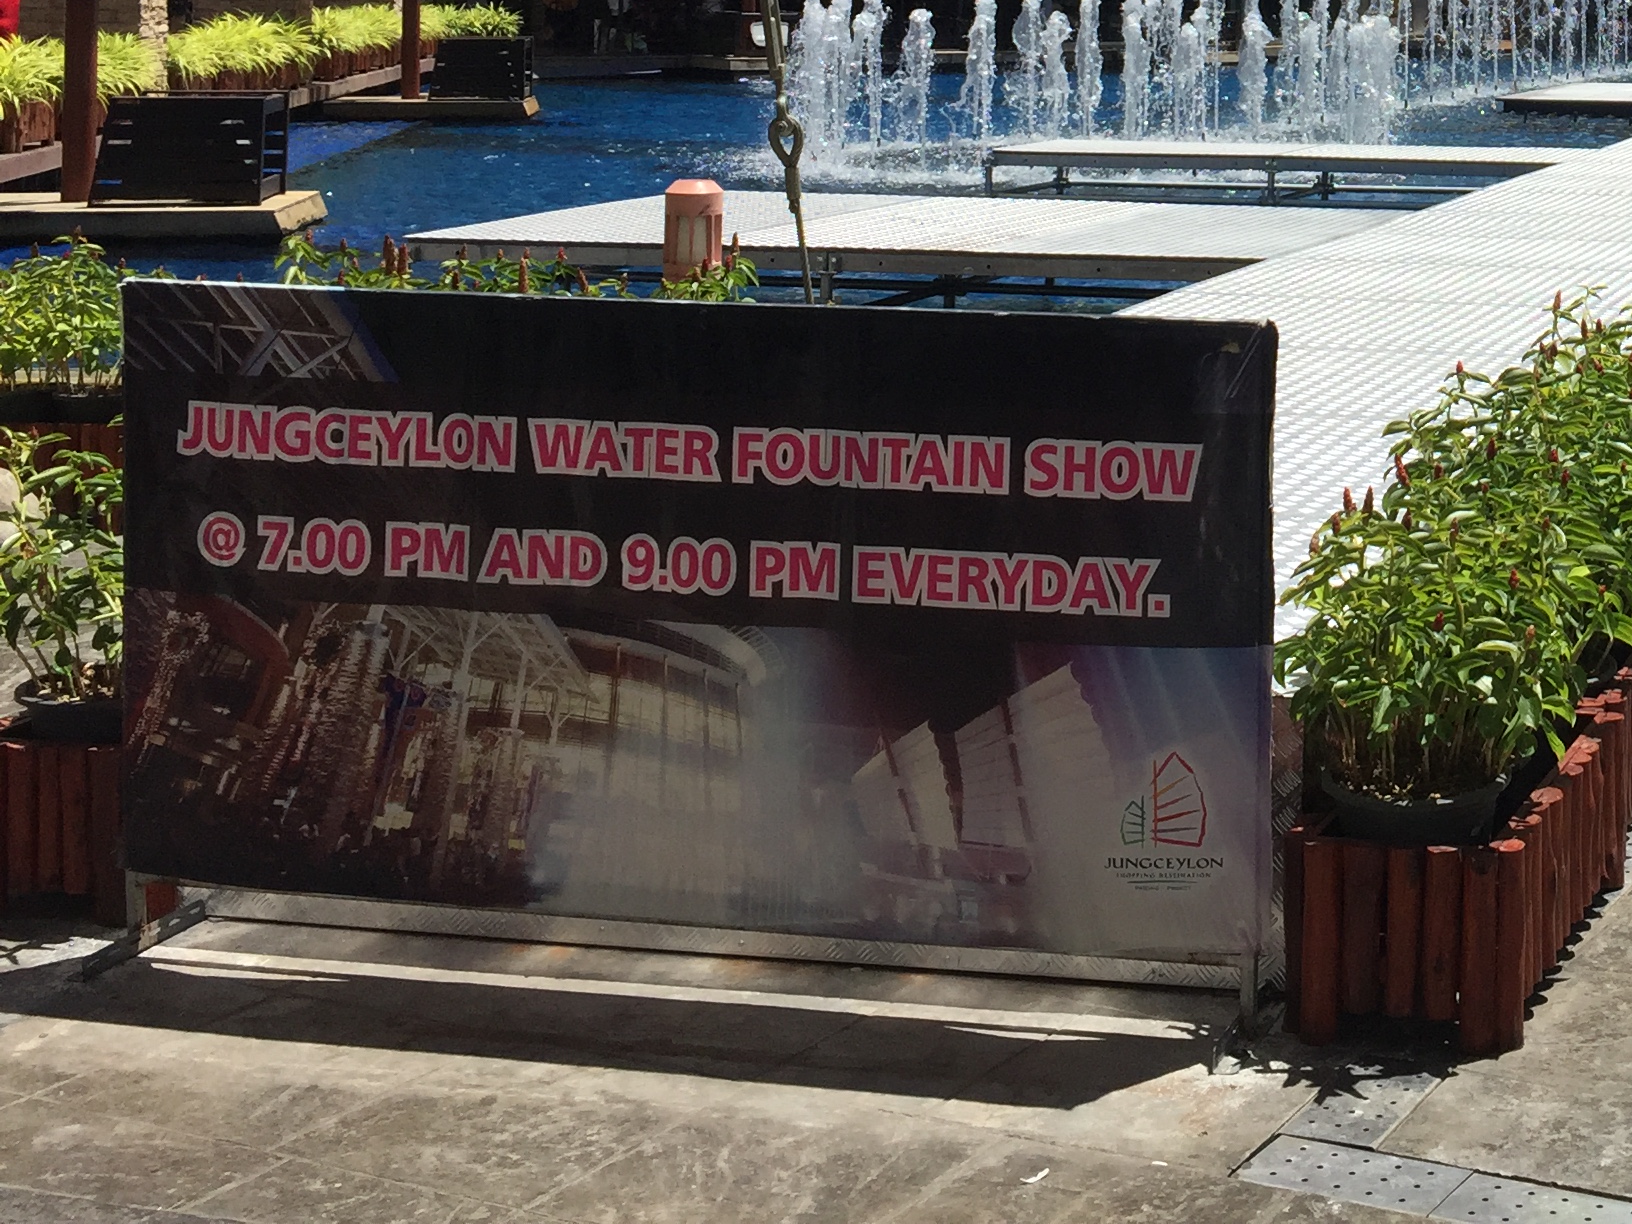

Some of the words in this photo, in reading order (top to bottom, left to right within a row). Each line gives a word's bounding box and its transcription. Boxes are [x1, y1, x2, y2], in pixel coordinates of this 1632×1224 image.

[177, 400, 519, 473] JUNGCEYLON
[526, 416, 722, 483] WATER
[732, 426, 1011, 496] FOUNTAIN
[1023, 437, 1204, 502] SHOW
[197, 510, 246, 567] @
[256, 514, 371, 575] 7.00
[383, 520, 471, 582] PM
[475, 526, 608, 588] AND
[620, 532, 737, 597] 9.00
[748, 539, 842, 601] PM
[850, 544, 1172, 618] EVERYDAY.
[1103, 857, 1223, 870] JUNGCEYLON
